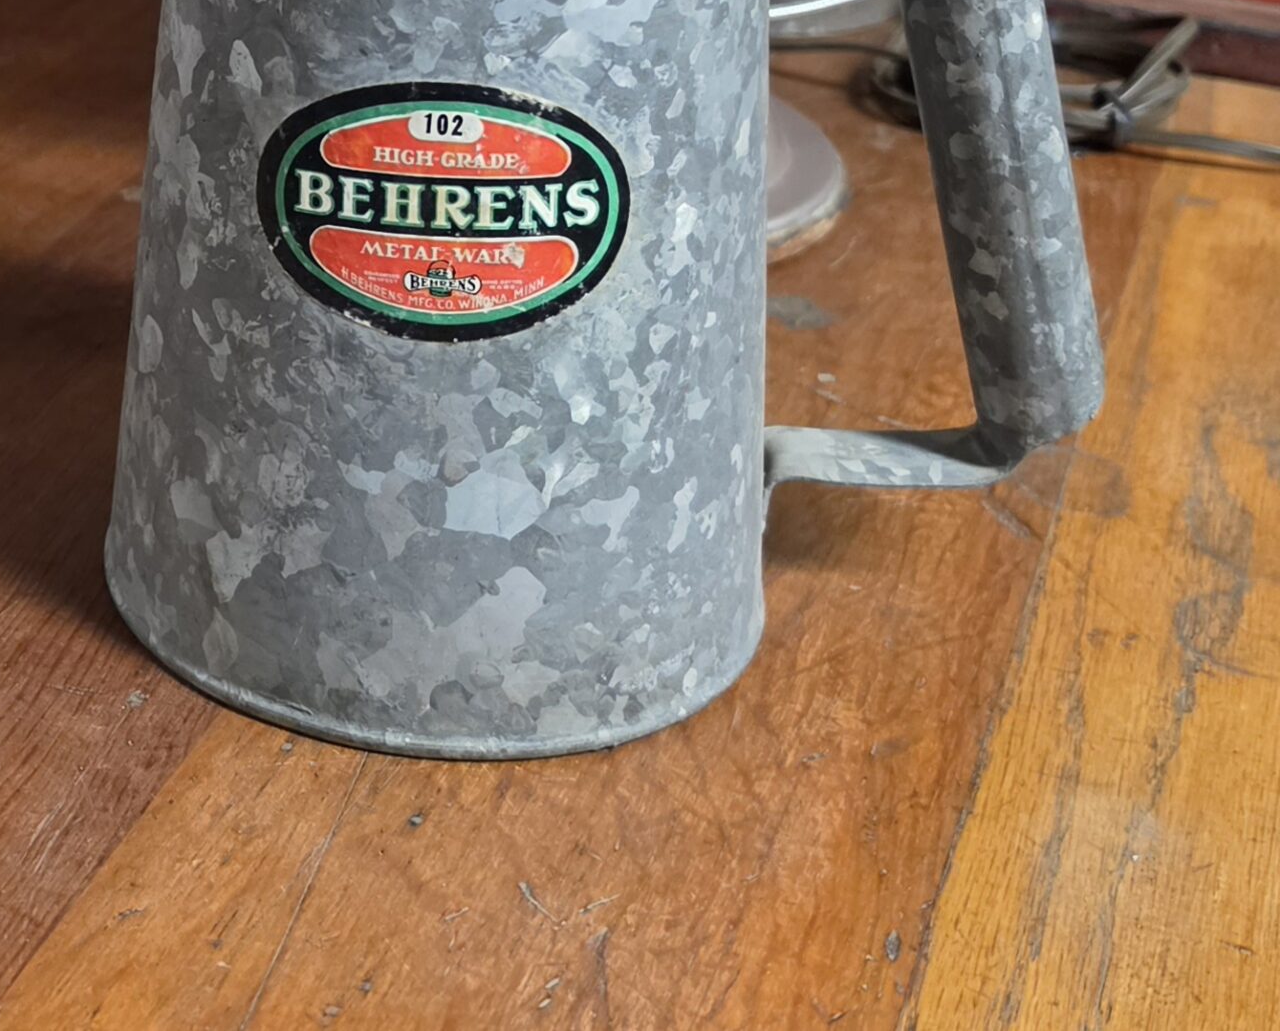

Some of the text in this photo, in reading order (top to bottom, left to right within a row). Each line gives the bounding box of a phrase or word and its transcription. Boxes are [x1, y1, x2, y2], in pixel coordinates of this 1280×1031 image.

[423, 112, 464, 136] 102
[293, 168, 602, 232] BEHRENS
[410, 274, 476, 292] BEHRENS
